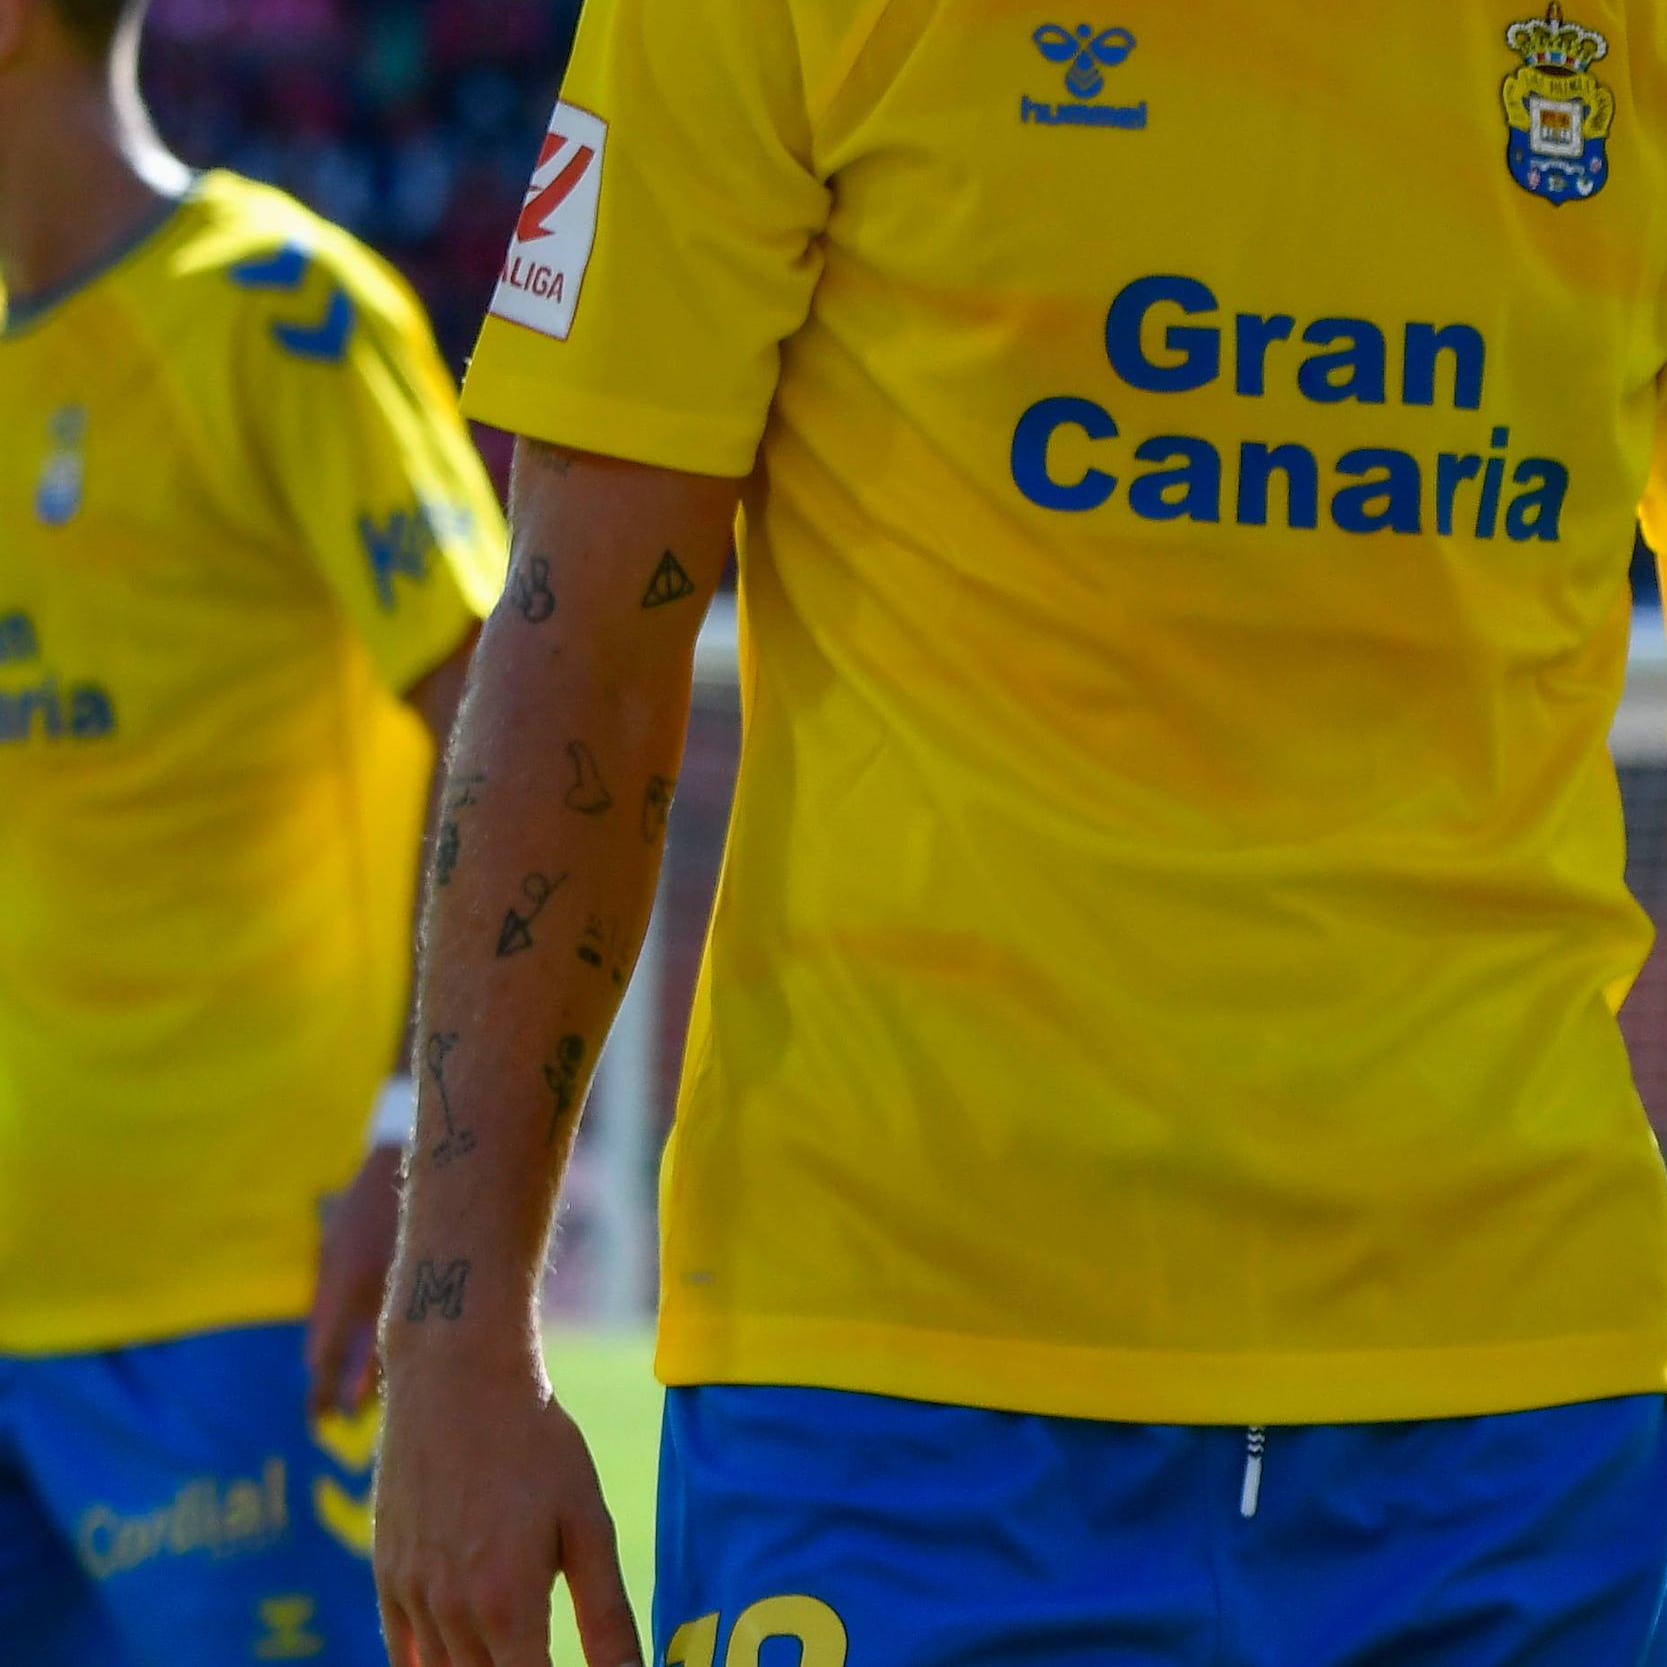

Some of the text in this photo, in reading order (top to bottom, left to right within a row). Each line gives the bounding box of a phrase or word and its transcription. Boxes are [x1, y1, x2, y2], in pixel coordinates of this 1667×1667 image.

[1020, 94, 1147, 130] hummel
[1104, 274, 1486, 410] Gran
[1010, 395, 1569, 542] Canaria
